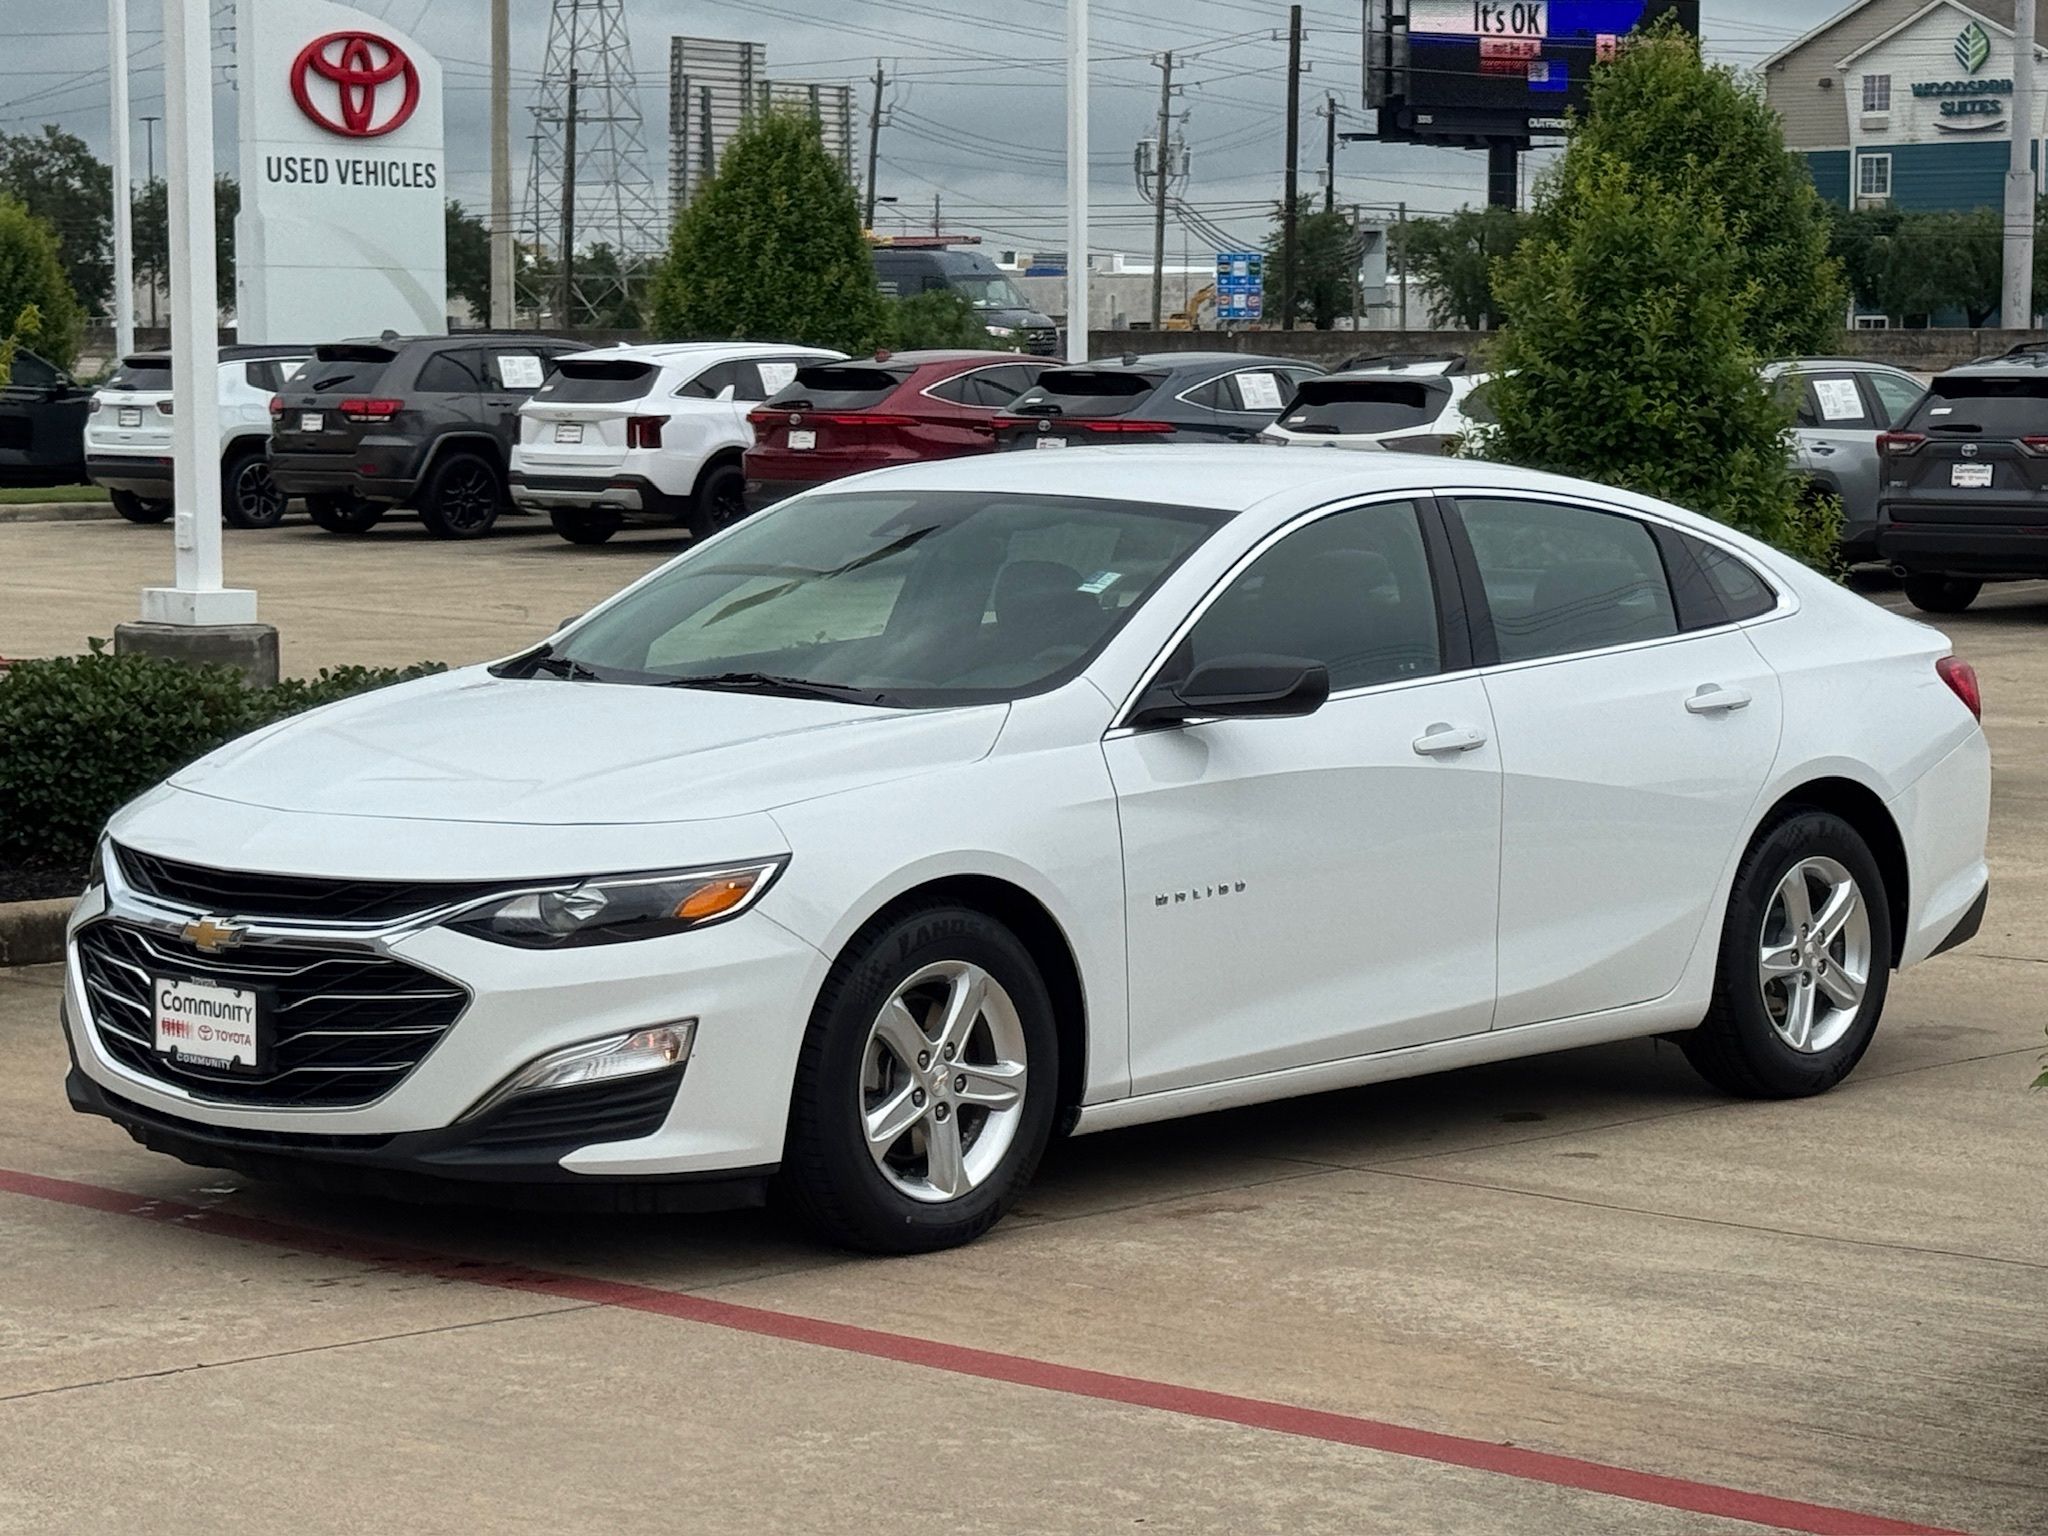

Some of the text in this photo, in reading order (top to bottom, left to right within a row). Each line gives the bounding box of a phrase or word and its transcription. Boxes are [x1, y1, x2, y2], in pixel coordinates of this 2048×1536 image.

[1474, 1, 1541, 35] It's OK
[1940, 100, 2001, 116] SUITES
[266, 156, 437, 188] USED VEHICLES
[214, 1029, 252, 1047] TOYOTA
[176, 1052, 231, 1070] COMMUNITY
